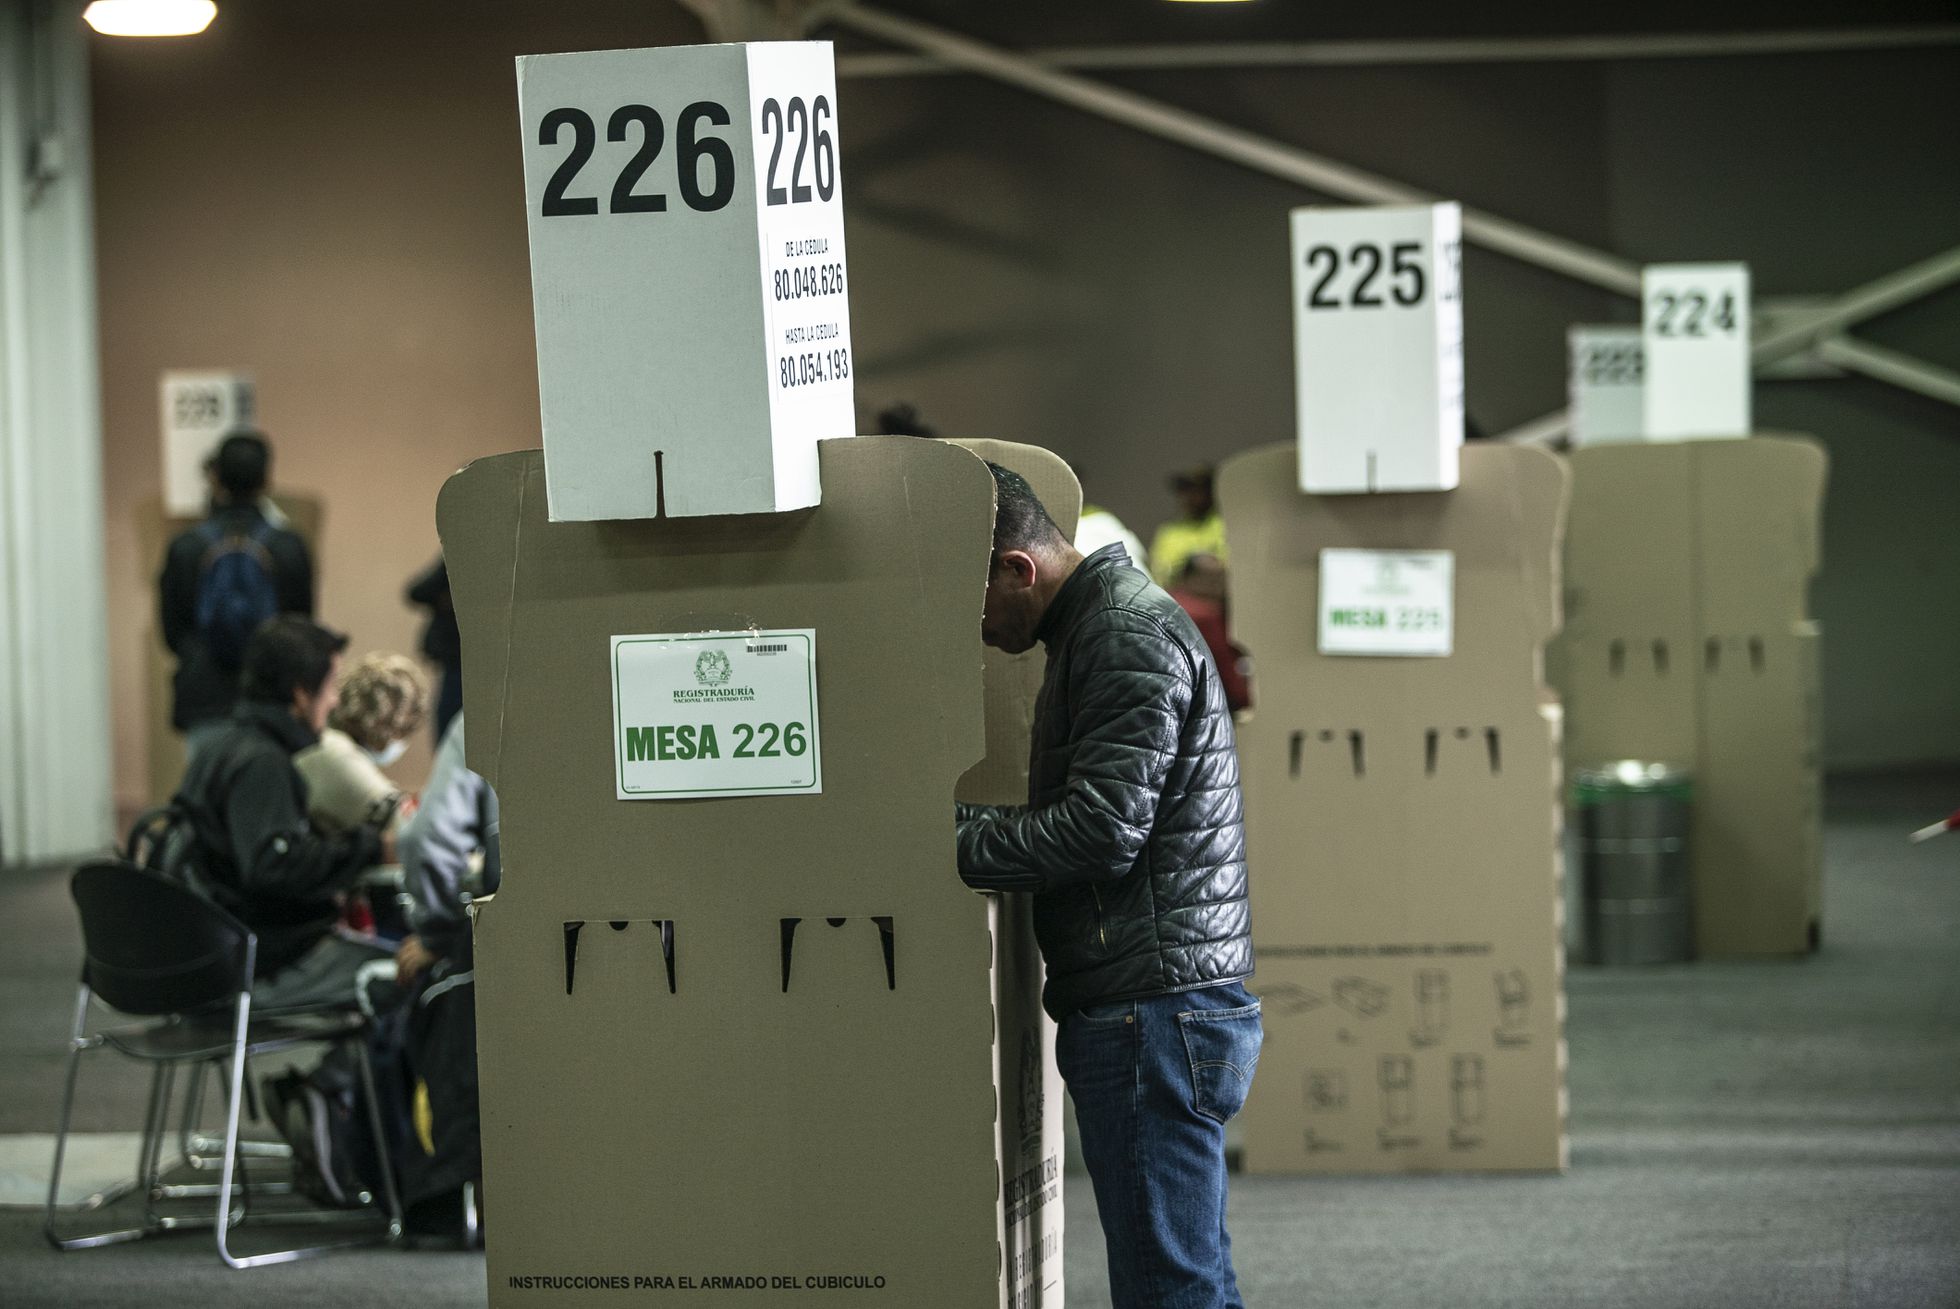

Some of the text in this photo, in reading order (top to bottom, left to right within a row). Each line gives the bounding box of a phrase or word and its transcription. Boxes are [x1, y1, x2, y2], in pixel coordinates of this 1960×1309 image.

[538, 100, 736, 217] 226
[761, 94, 835, 207] 226
[785, 241, 795, 258] DE
[795, 239, 804, 257] LA
[774, 262, 843, 302] 80.048.626
[1305, 241, 1426, 310] 225
[1653, 288, 1738, 338] 224
[785, 327, 806, 345] HASTA
[806, 325, 815, 342] LA
[780, 347, 849, 389] 80.054.193
[1329, 606, 1387, 630] MESA
[672, 685, 755, 698] REGISTRADURÍA
[626, 721, 807, 762] MESA 226
[508, 1275, 886, 1290] INSTRUCCIONES PARA EL ARMADO DEL CUBICULO
